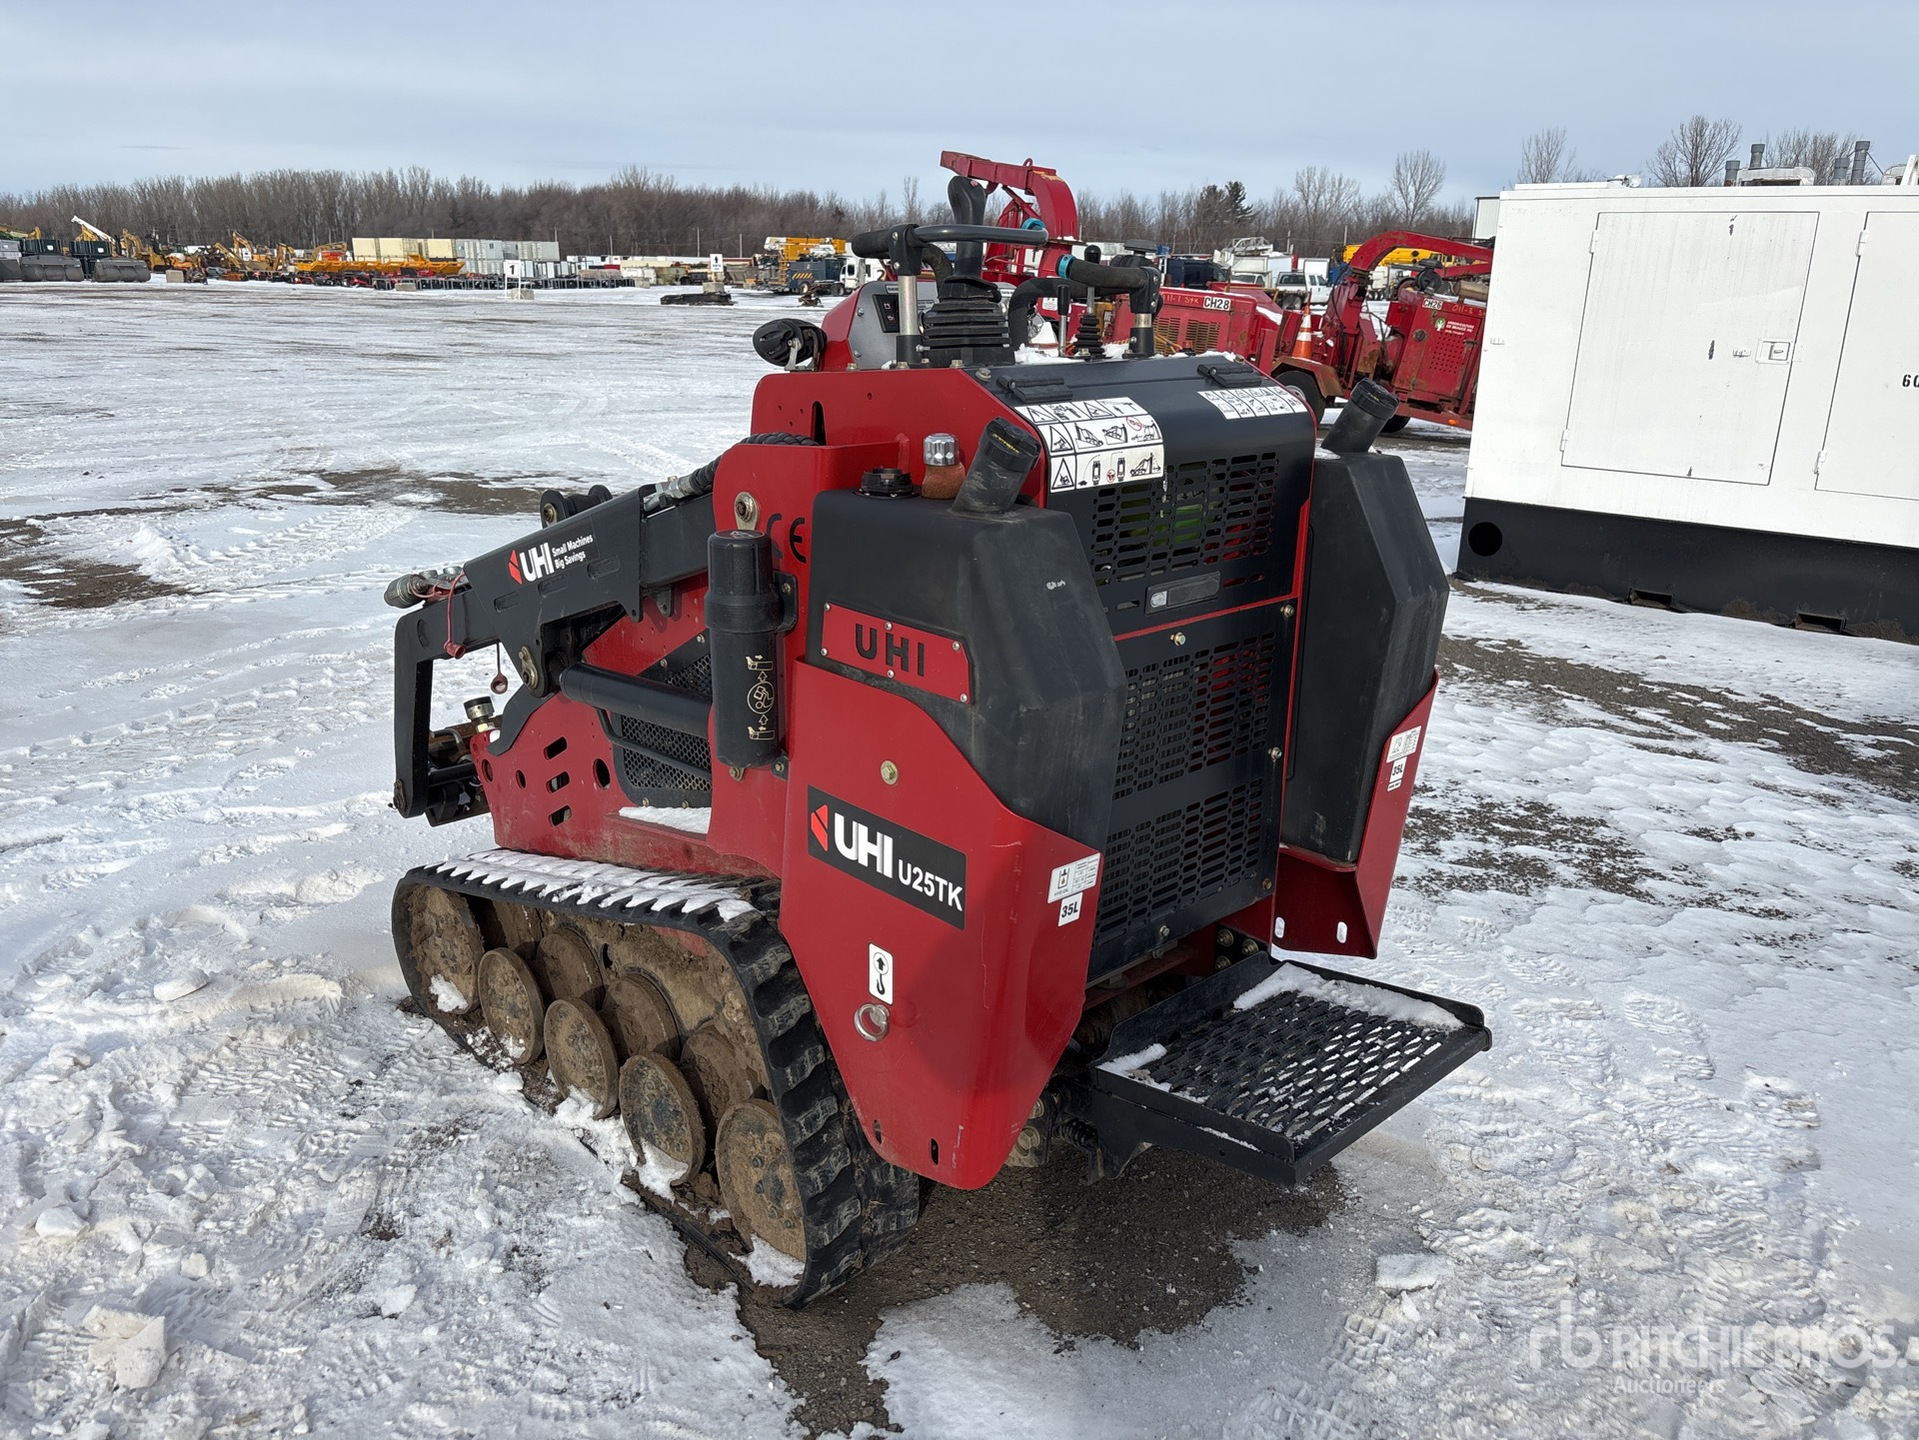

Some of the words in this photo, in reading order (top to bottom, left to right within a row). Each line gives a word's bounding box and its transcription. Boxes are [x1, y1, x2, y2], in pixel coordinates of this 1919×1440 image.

[509, 265, 515, 275] 1
[1203, 297, 1230, 310] CH28
[552, 543, 568, 557] Small
[566, 534, 594, 551] Machines
[766, 513, 807, 564] CE
[519, 542, 555, 582] UHI
[554, 557, 566, 570] Big
[564, 550, 586, 566] Savings
[855, 623, 925, 677] UHI
[834, 812, 894, 879] UHI
[898, 858, 963, 912] U25TK
[1061, 900, 1079, 919] 35L
